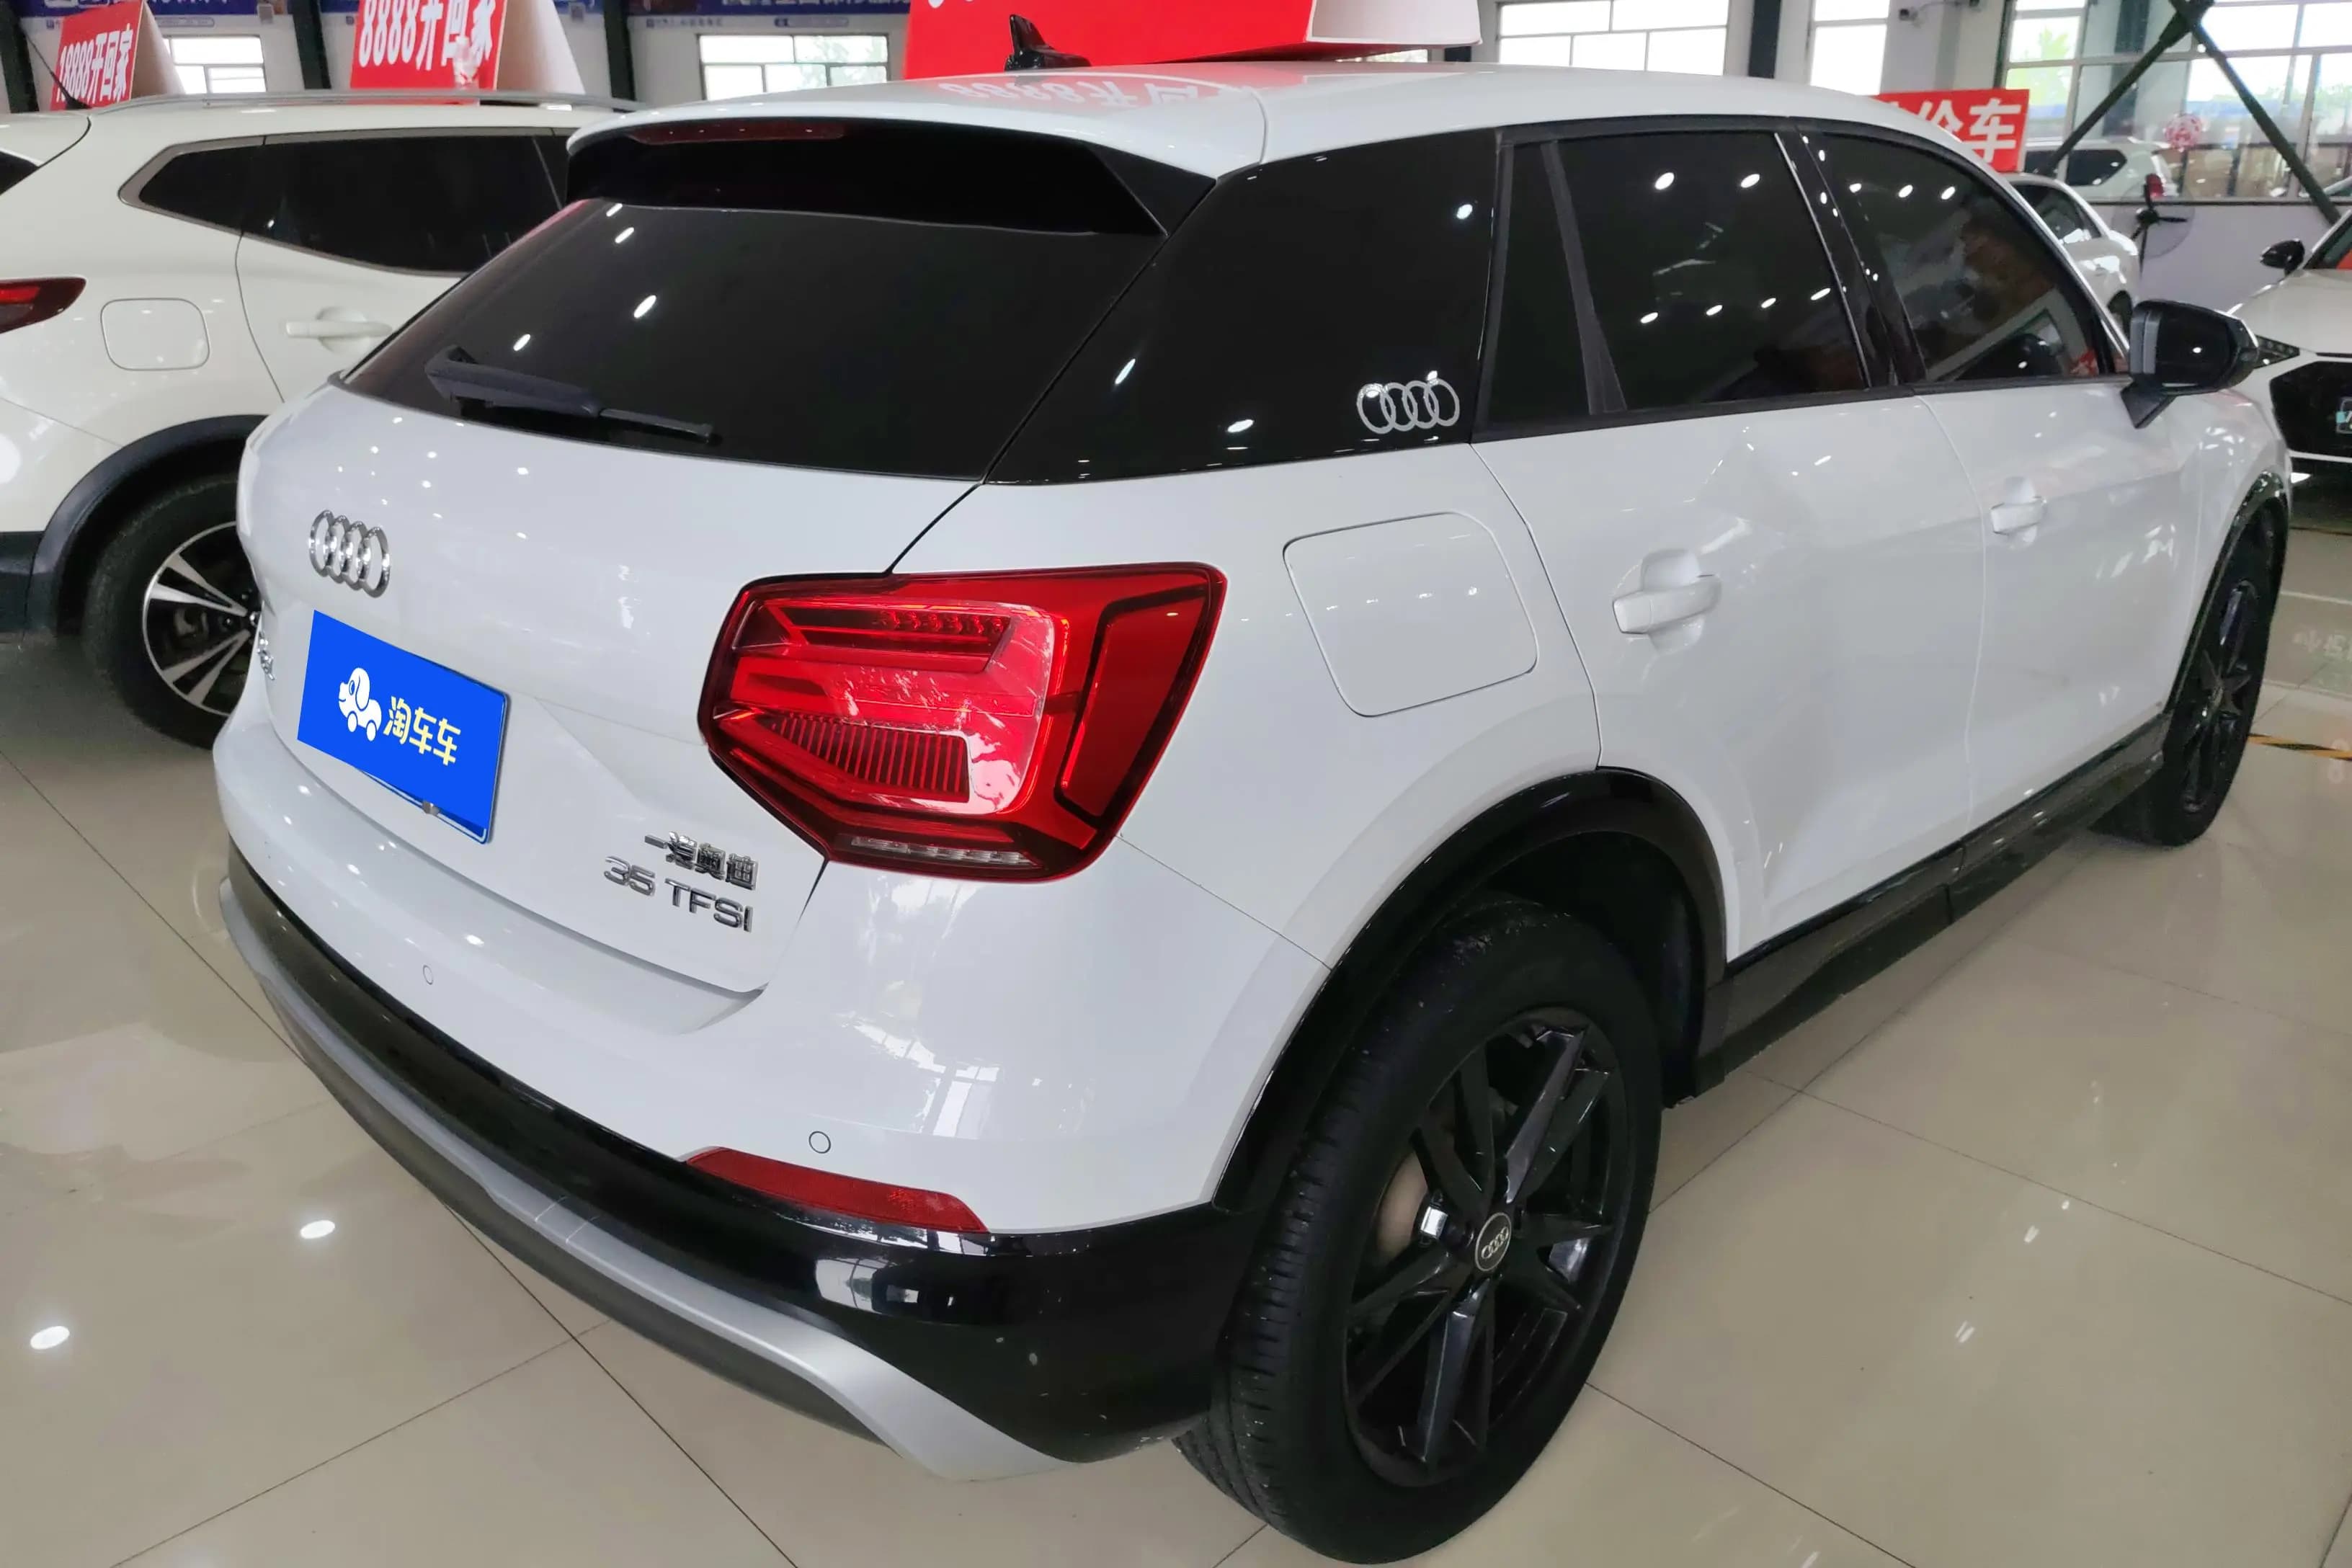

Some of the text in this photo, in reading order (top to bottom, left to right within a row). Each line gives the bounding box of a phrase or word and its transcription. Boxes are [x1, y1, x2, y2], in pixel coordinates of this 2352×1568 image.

[56, 23, 133, 104] 18888开回家
[604, 855, 753, 932] 35 TFSI
